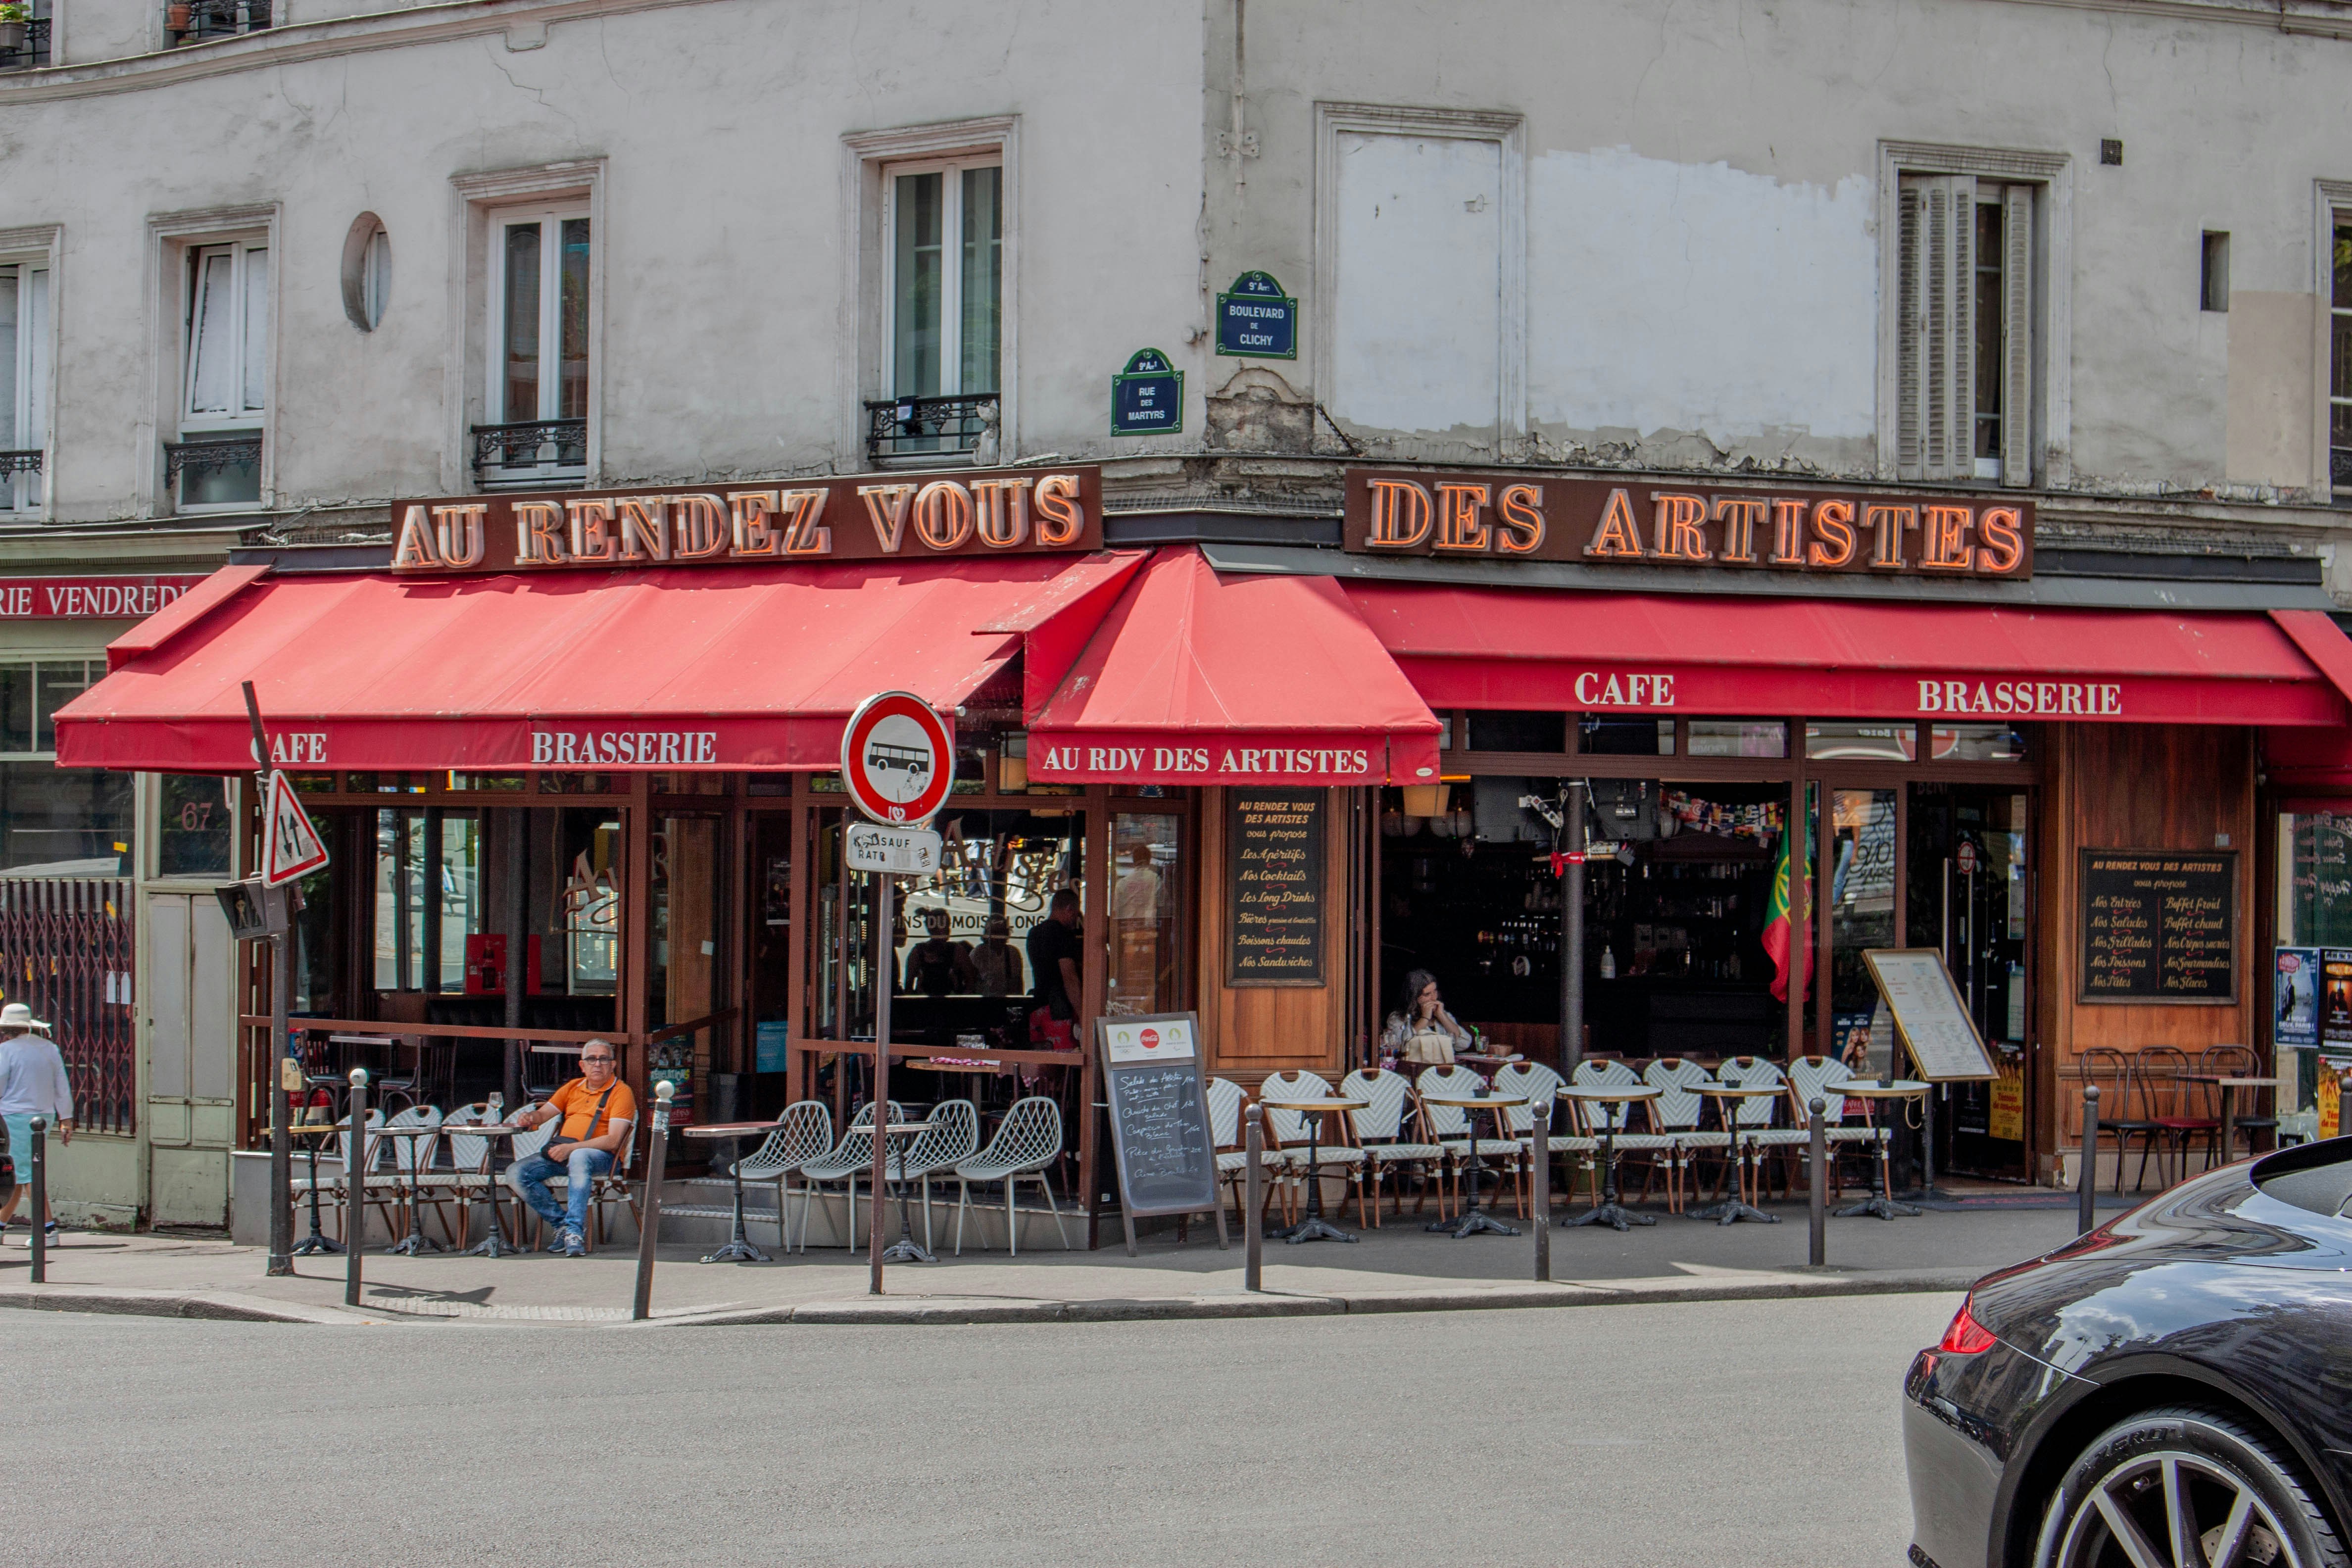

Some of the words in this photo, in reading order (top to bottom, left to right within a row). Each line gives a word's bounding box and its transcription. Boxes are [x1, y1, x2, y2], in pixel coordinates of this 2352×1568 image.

[1229, 305, 1285, 319] BOULEVARD
[1240, 334, 1273, 345] CLICHY
[1139, 387, 1155, 396] RUE
[1128, 410, 1165, 420] MARTYRS
[391, 503, 488, 569] AU
[511, 488, 832, 566] RENDEZ
[857, 475, 1085, 553] VOUS
[1365, 478, 1546, 554] DES
[1584, 488, 2024, 574] ARTISTES
[47, 586, 188, 615] VENDRED
[1574, 672, 1674, 706] CAFE
[1917, 681, 2121, 715] BRASSERIE
[532, 733, 717, 764] BRASSERIE
[1042, 747, 1080, 770] AU
[1088, 748, 1145, 771] RDV
[1153, 748, 1209, 772] DES
[1218, 749, 1368, 773] ARTISTES
[1239, 802, 1252, 811] AU
[1253, 802, 1289, 811] RENDEZ
[1291, 802, 1315, 811] VOUS
[182, 802, 212, 831] 67
[1245, 814, 1263, 824] DES
[1264, 815, 1309, 824] ARTISTES
[1270, 830, 1307, 841] propose
[881, 837, 910, 848] SAUF
[1240, 848, 1257, 859] Les
[1258, 848, 1306, 863] Apéritifs
[2092, 861, 2104, 870] AU
[2105, 861, 2138, 870] RENDEZ
[2140, 862, 2160, 871] VOUS
[2163, 862, 2179, 871] DES
[2181, 863, 2223, 872] ARTISTES
[1239, 870, 1258, 881] Nos
[1260, 870, 1306, 881] Cocktails
[2154, 880, 2187, 890] propose
[1240, 892, 1256, 902] Les
[1258, 891, 1280, 906] Long
[1281, 891, 1315, 902] Drinks
[2091, 895, 2107, 908] Nos
[2196, 897, 2221, 912] froid
[891, 917, 922, 929] INS
[927, 917, 946, 929] DU
[2091, 916, 2107, 927] Nos
[2110, 916, 2148, 929] Salades
[2195, 917, 2223, 929] chaud
[1238, 934, 1274, 945] Boissons
[1276, 934, 1311, 945] chaudes
[2091, 935, 2107, 947] Nos
[2107, 935, 2152, 949] Grillades
[2164, 936, 2179, 948] Nos
[1239, 956, 1256, 967] Nos
[1258, 956, 1313, 967] Sandwiches
[2091, 955, 2107, 968] Nos
[2108, 955, 2146, 968] Poissons
[2164, 956, 2178, 968] Nos
[2091, 975, 2106, 987] Nos
[2164, 975, 2179, 987] Nos
